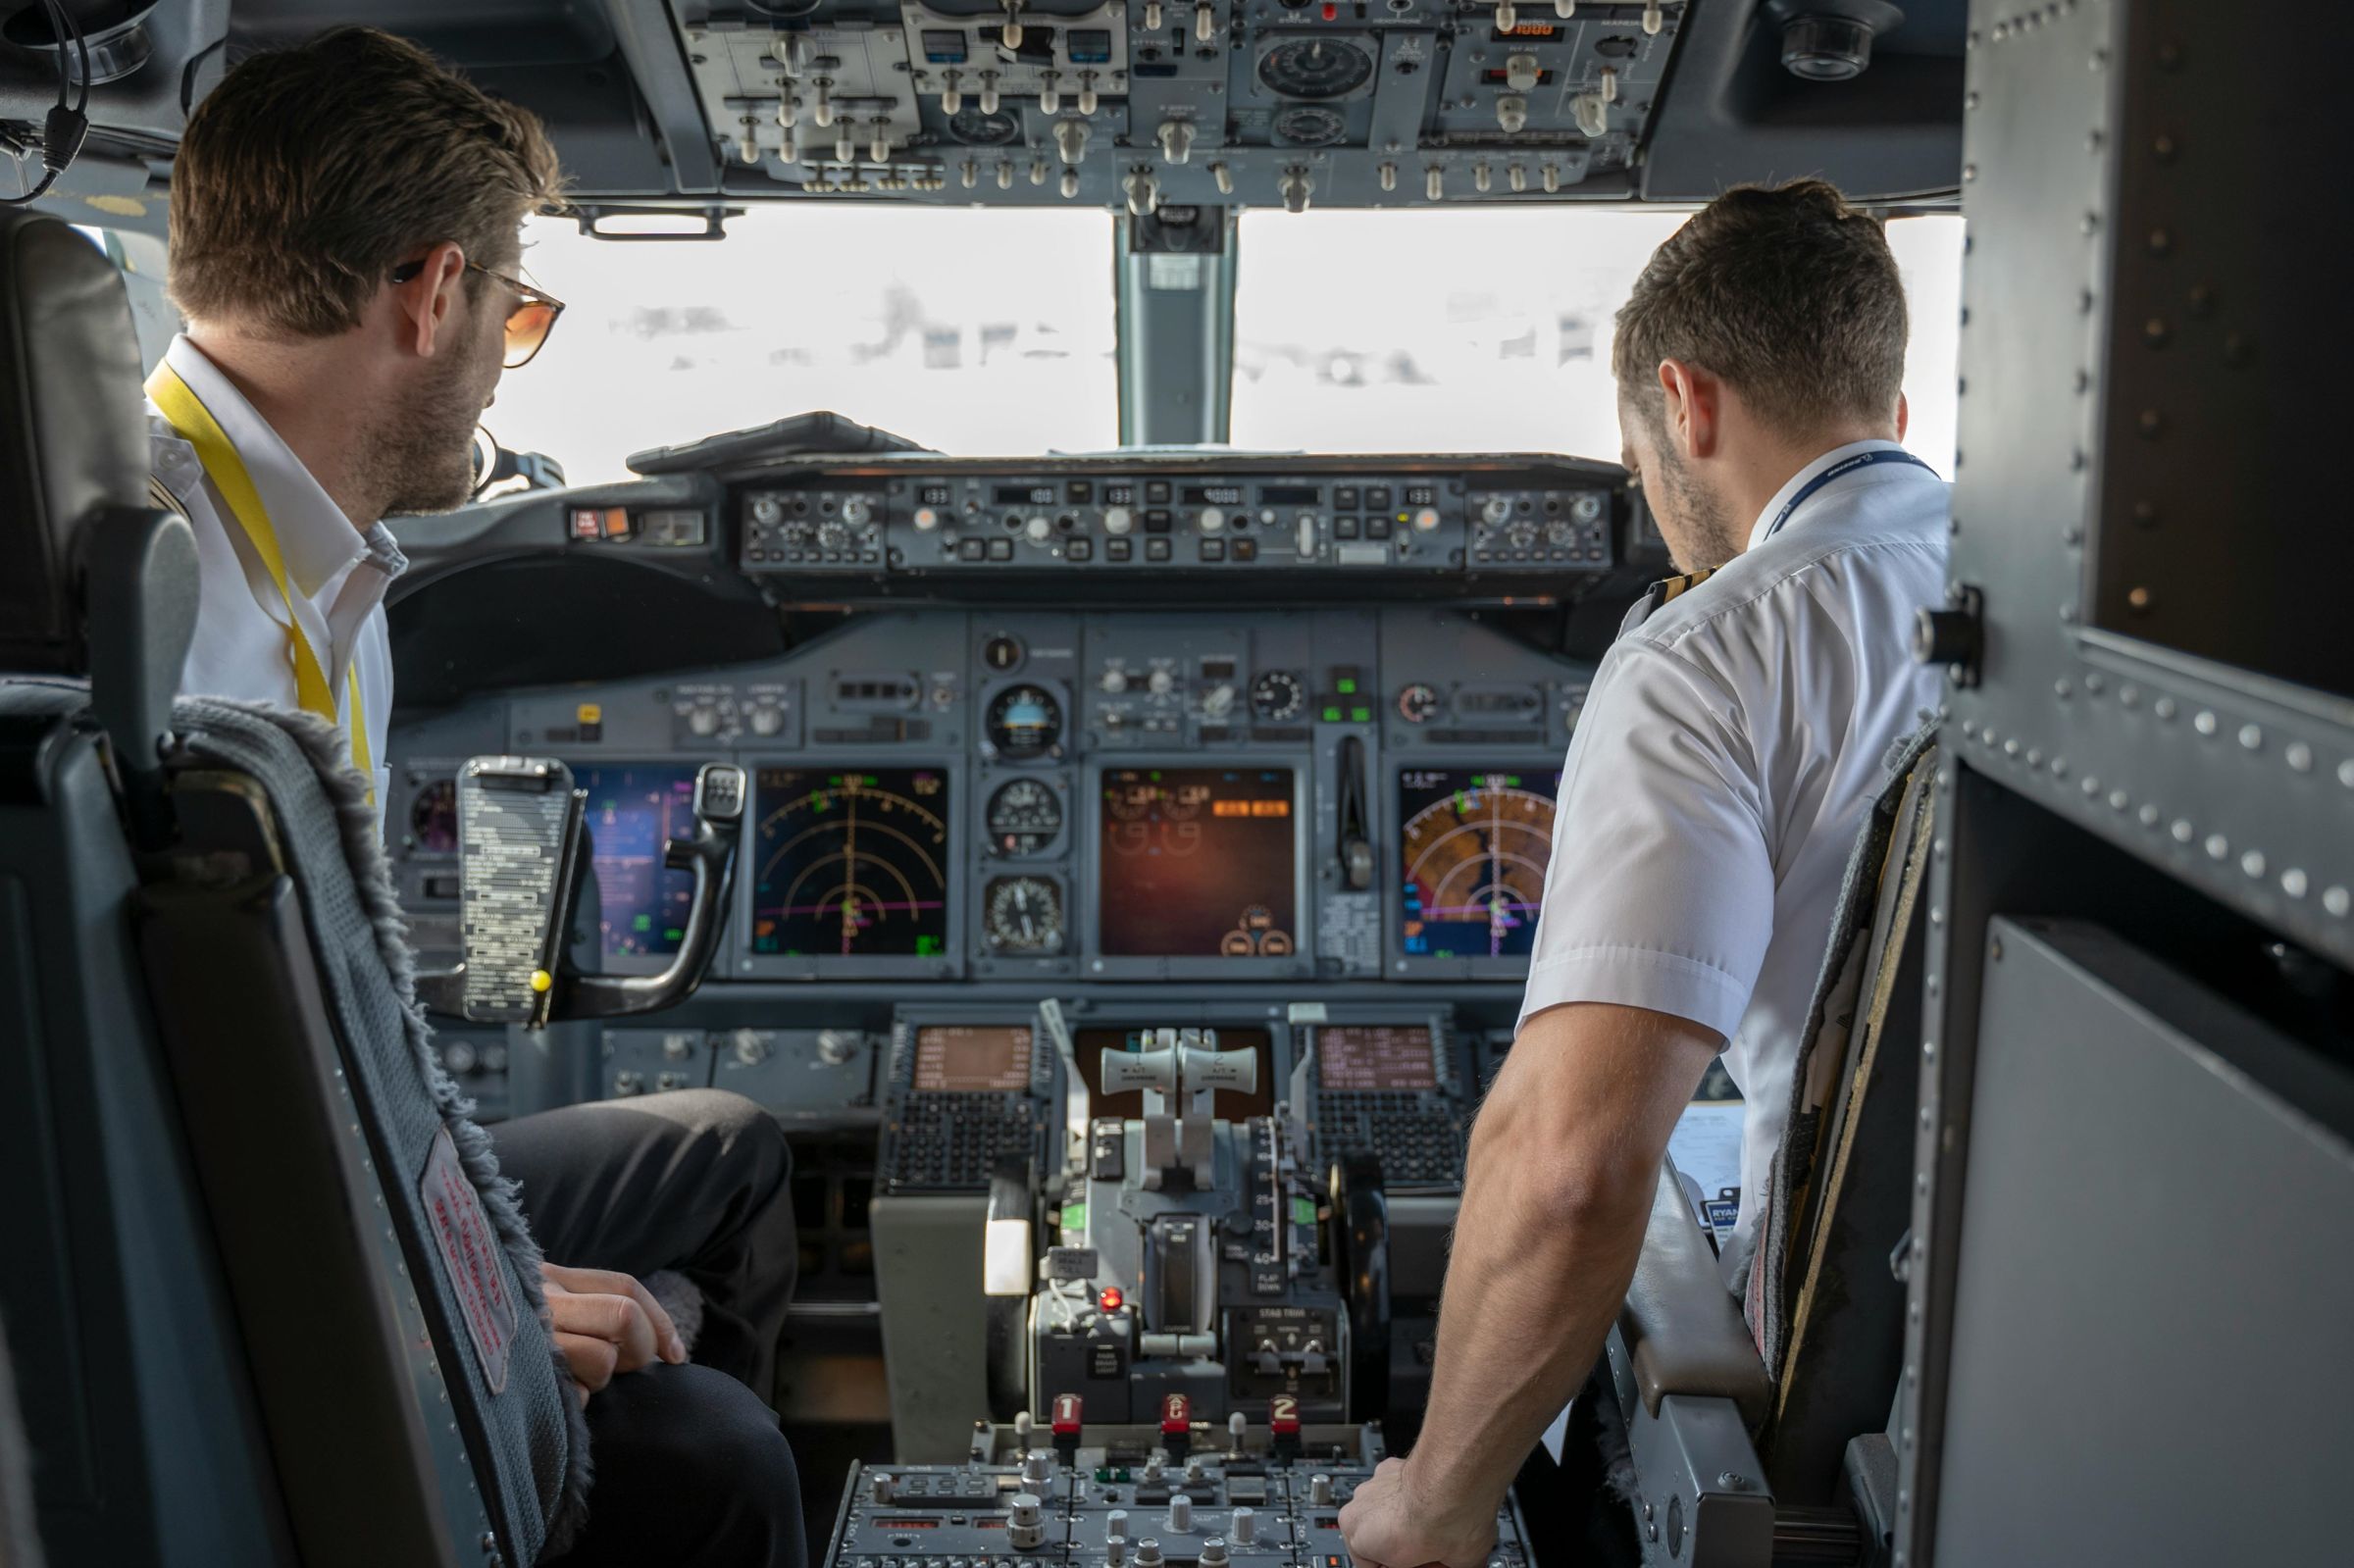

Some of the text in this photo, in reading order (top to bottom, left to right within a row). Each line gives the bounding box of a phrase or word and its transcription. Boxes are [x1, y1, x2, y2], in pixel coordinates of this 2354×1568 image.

[1214, 1054, 1224, 1066] 2
[1255, 1194, 1269, 1205] 25
[1254, 1220, 1269, 1232] 30
[1254, 1252, 1270, 1264] 40
[1258, 1308, 1305, 1318] STAB TRIM
[1060, 1398, 1073, 1419] 1
[1273, 1398, 1297, 1420] 2
